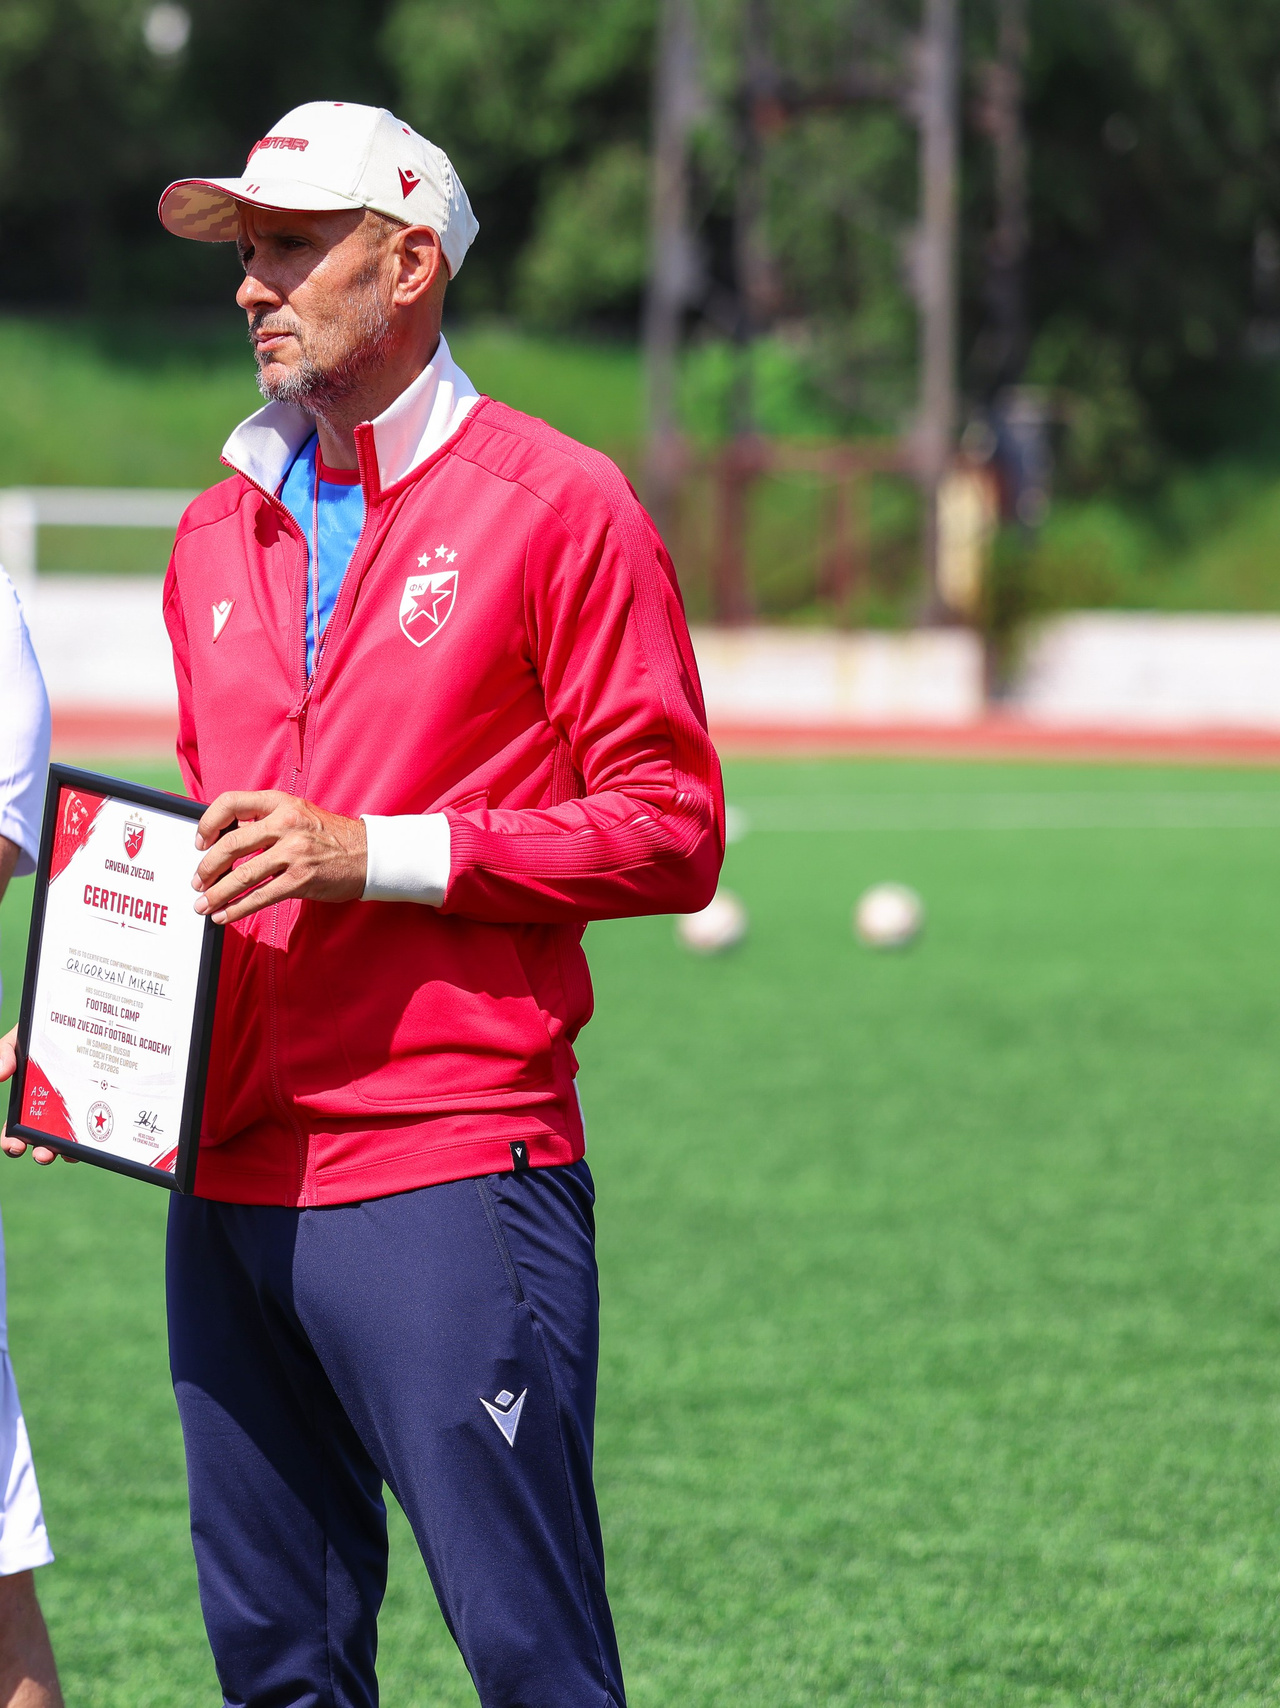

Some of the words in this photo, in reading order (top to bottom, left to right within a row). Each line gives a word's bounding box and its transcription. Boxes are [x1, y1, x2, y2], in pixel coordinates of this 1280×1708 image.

[105, 858, 129, 876] CRVENA
[130, 866, 154, 882] ZVEZDA
[83, 884, 168, 926] CERTIFICATE
[87, 952, 109, 964] CERTIFICATE
[66, 958, 126, 984] GRIGORYAN
[128, 975, 166, 996] MIKAEL
[86, 998, 118, 1017] FOOTBALL
[120, 1008, 140, 1022] CAMP
[50, 1011, 76, 1029] CRVENA
[77, 1019, 103, 1037] ZVEZDA
[104, 1027, 137, 1047] FOOTBALL
[138, 1037, 172, 1056] ACADEMY
[76, 1045, 89, 1055] WITH
[89, 1048, 105, 1061] COACH
[105, 1053, 119, 1065] FROM
[120, 1058, 138, 1071] EUROPE
[113, 1045, 131, 1058] RUSSIA
[30, 1086, 37, 1097] A
[37, 1086, 50, 1099] Star
